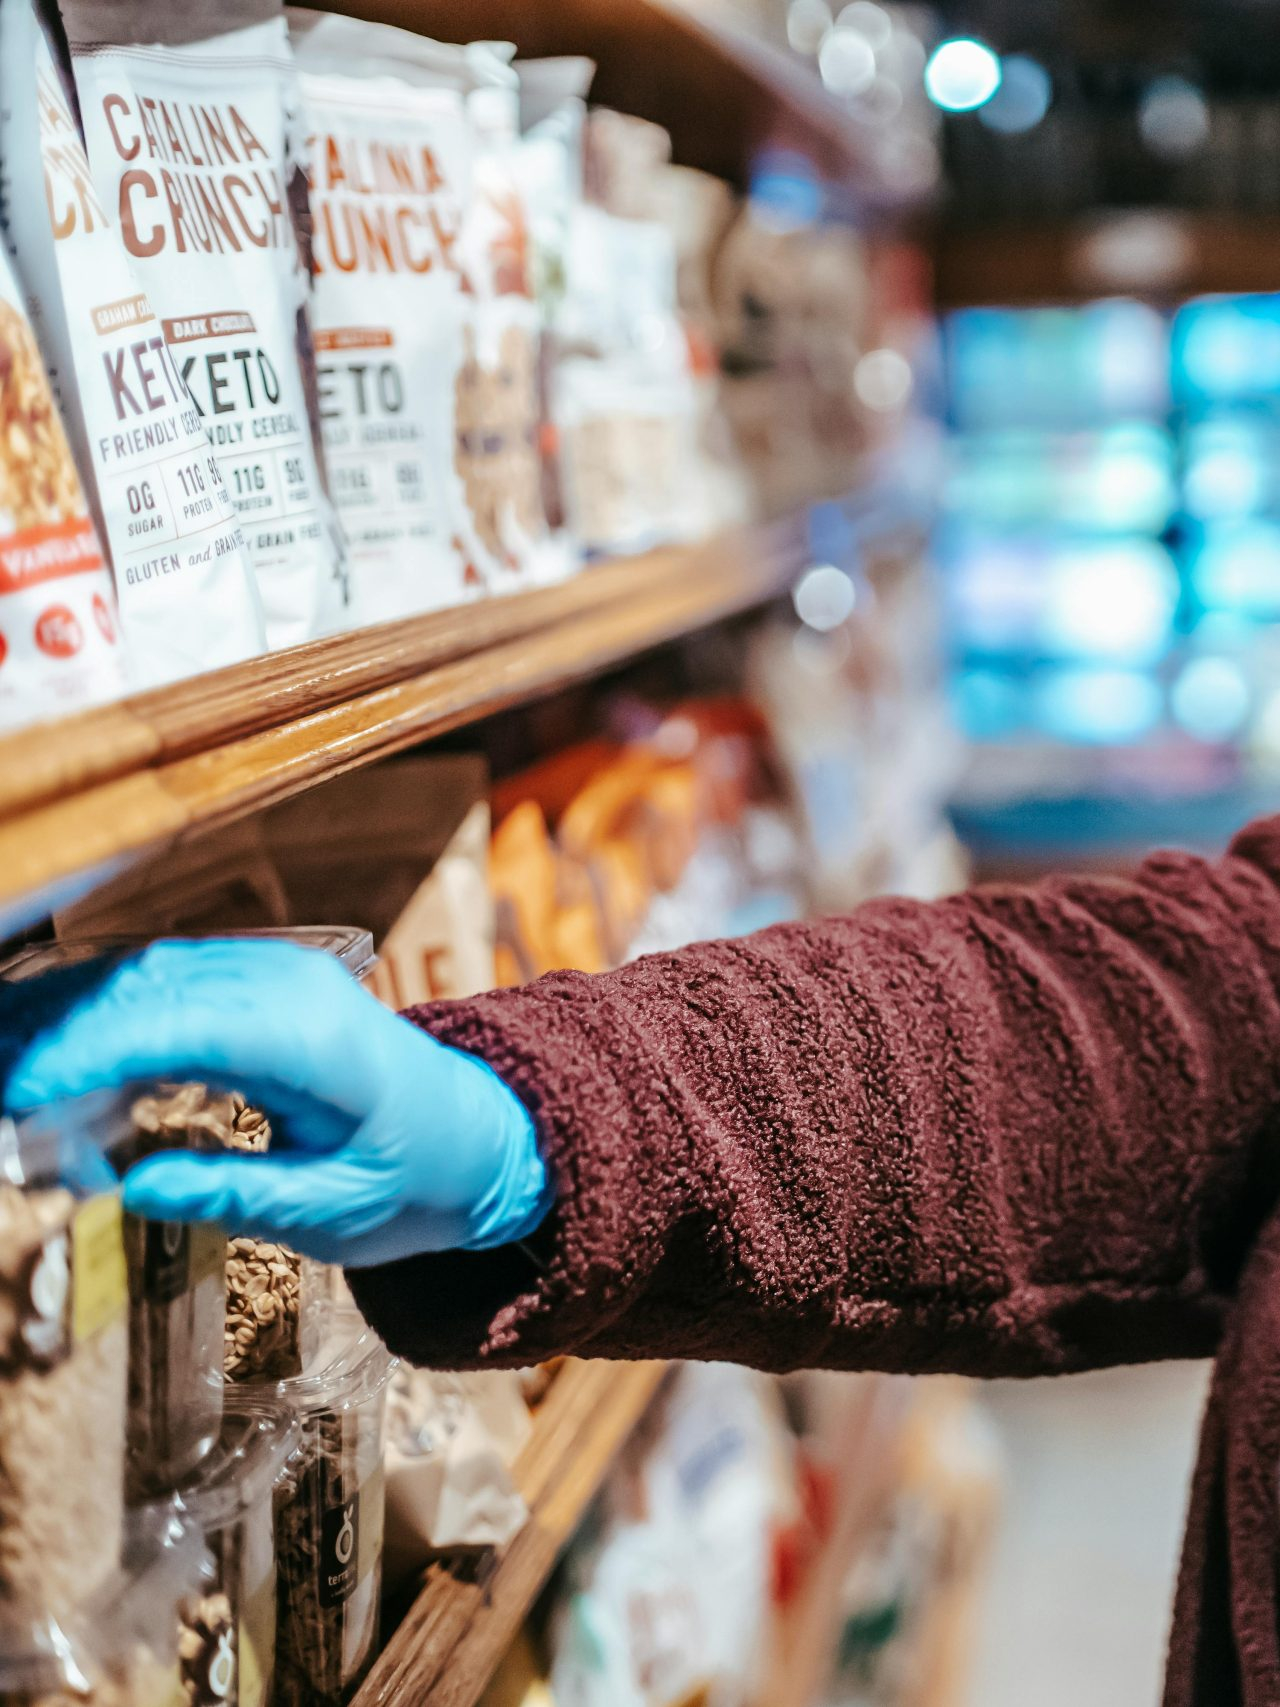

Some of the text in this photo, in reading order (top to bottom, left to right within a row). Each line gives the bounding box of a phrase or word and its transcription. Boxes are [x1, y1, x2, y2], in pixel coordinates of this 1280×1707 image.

[103, 93, 269, 165] CATALINA
[119, 169, 290, 258] CRUNCH
[310, 200, 462, 275] UNCH
[172, 318, 209, 340] DARK
[181, 347, 280, 417] KETO
[318, 361, 404, 419] ETO
[98, 416, 180, 463] FRIENDLY
[176, 463, 206, 497] 11G
[233, 465, 265, 494] 11G
[128, 516, 164, 537] SUGAR
[126, 553, 181, 585] GLUTEN
[188, 544, 213, 567] and
